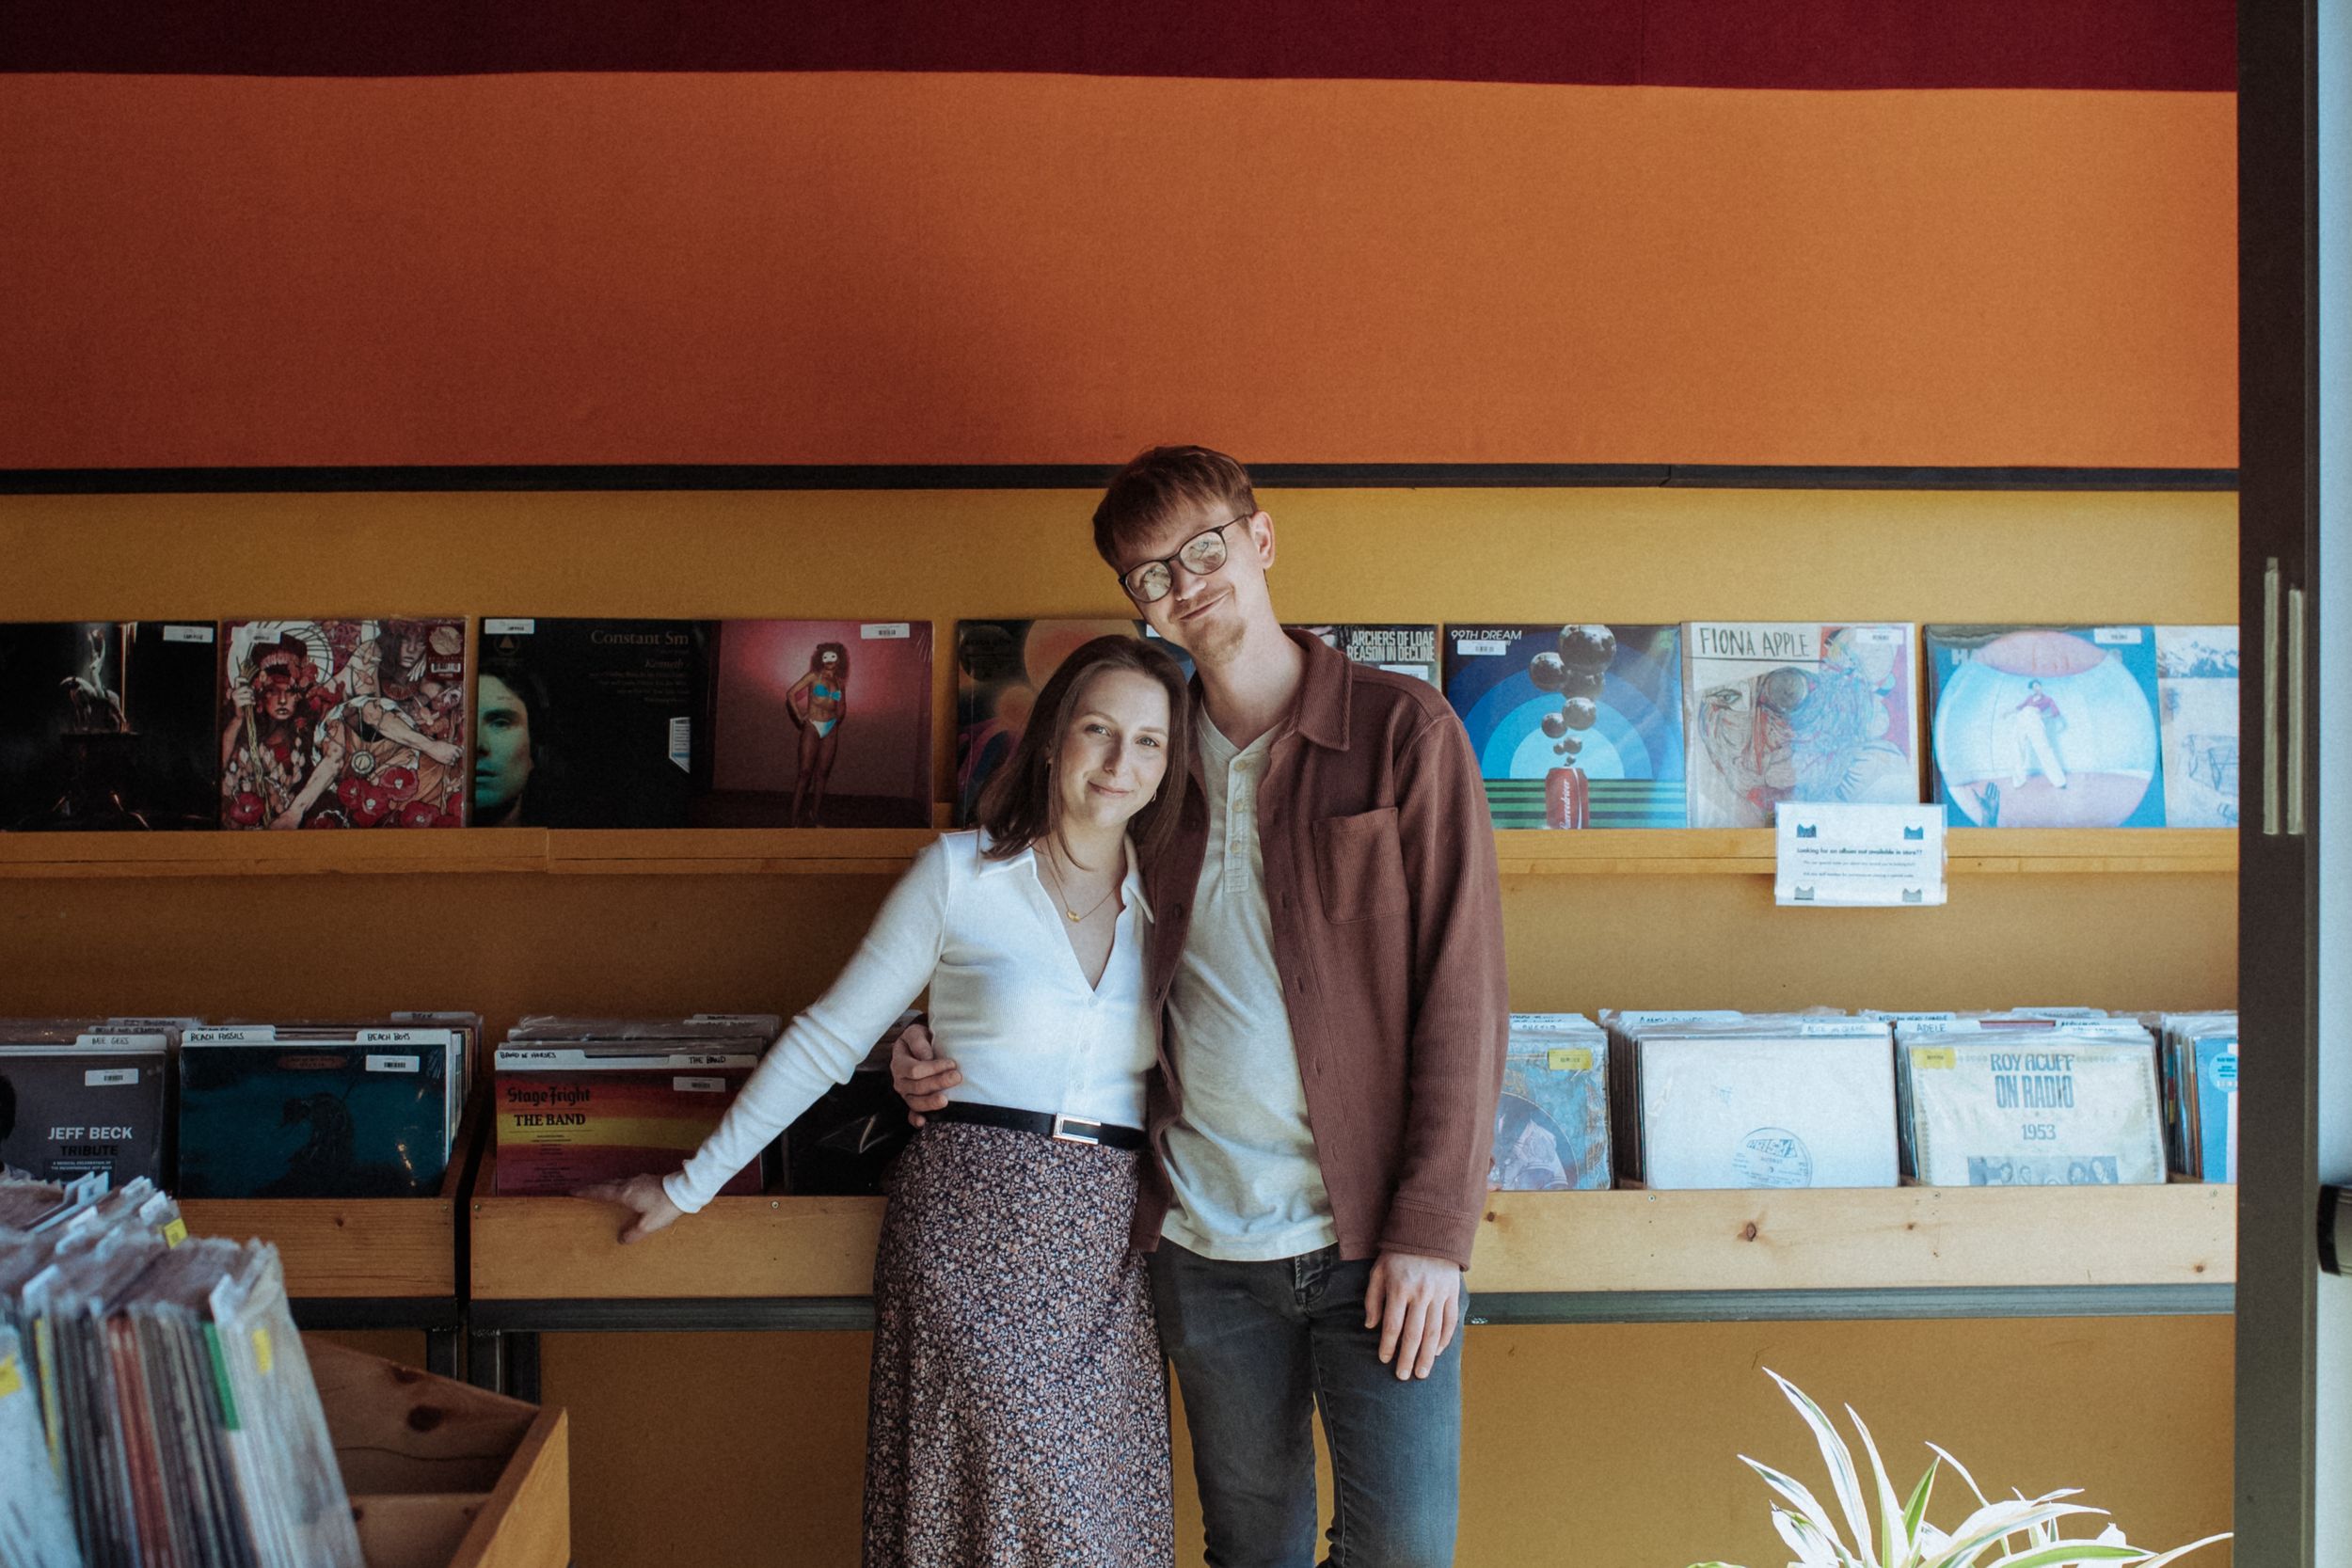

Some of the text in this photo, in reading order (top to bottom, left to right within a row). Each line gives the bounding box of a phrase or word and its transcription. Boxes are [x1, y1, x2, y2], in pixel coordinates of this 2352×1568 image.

[591, 629, 660, 645] Constant
[1352, 631, 1434, 646] ARCHERS OF LOAF
[1451, 630, 1522, 641] 99TH DREAM
[1699, 627, 1810, 657] FIONA APPLE
[1346, 645, 1436, 661] REASON IN DECLINE
[1916, 1023, 1947, 1033] ADELE
[191, 1032, 245, 1041] BEACH FOSSILS
[367, 1033, 411, 1041] BEACH BOYS
[1990, 1053, 2075, 1071] ROY ACUFF
[507, 1085, 591, 1106] Stage Fright
[1994, 1075, 2075, 1108] ON RADIO
[514, 1114, 586, 1127] THE BAND
[48, 1127, 133, 1140] JEFF BECK
[2021, 1124, 2057, 1140] 1953
[60, 1145, 119, 1156] TRIBUTE
